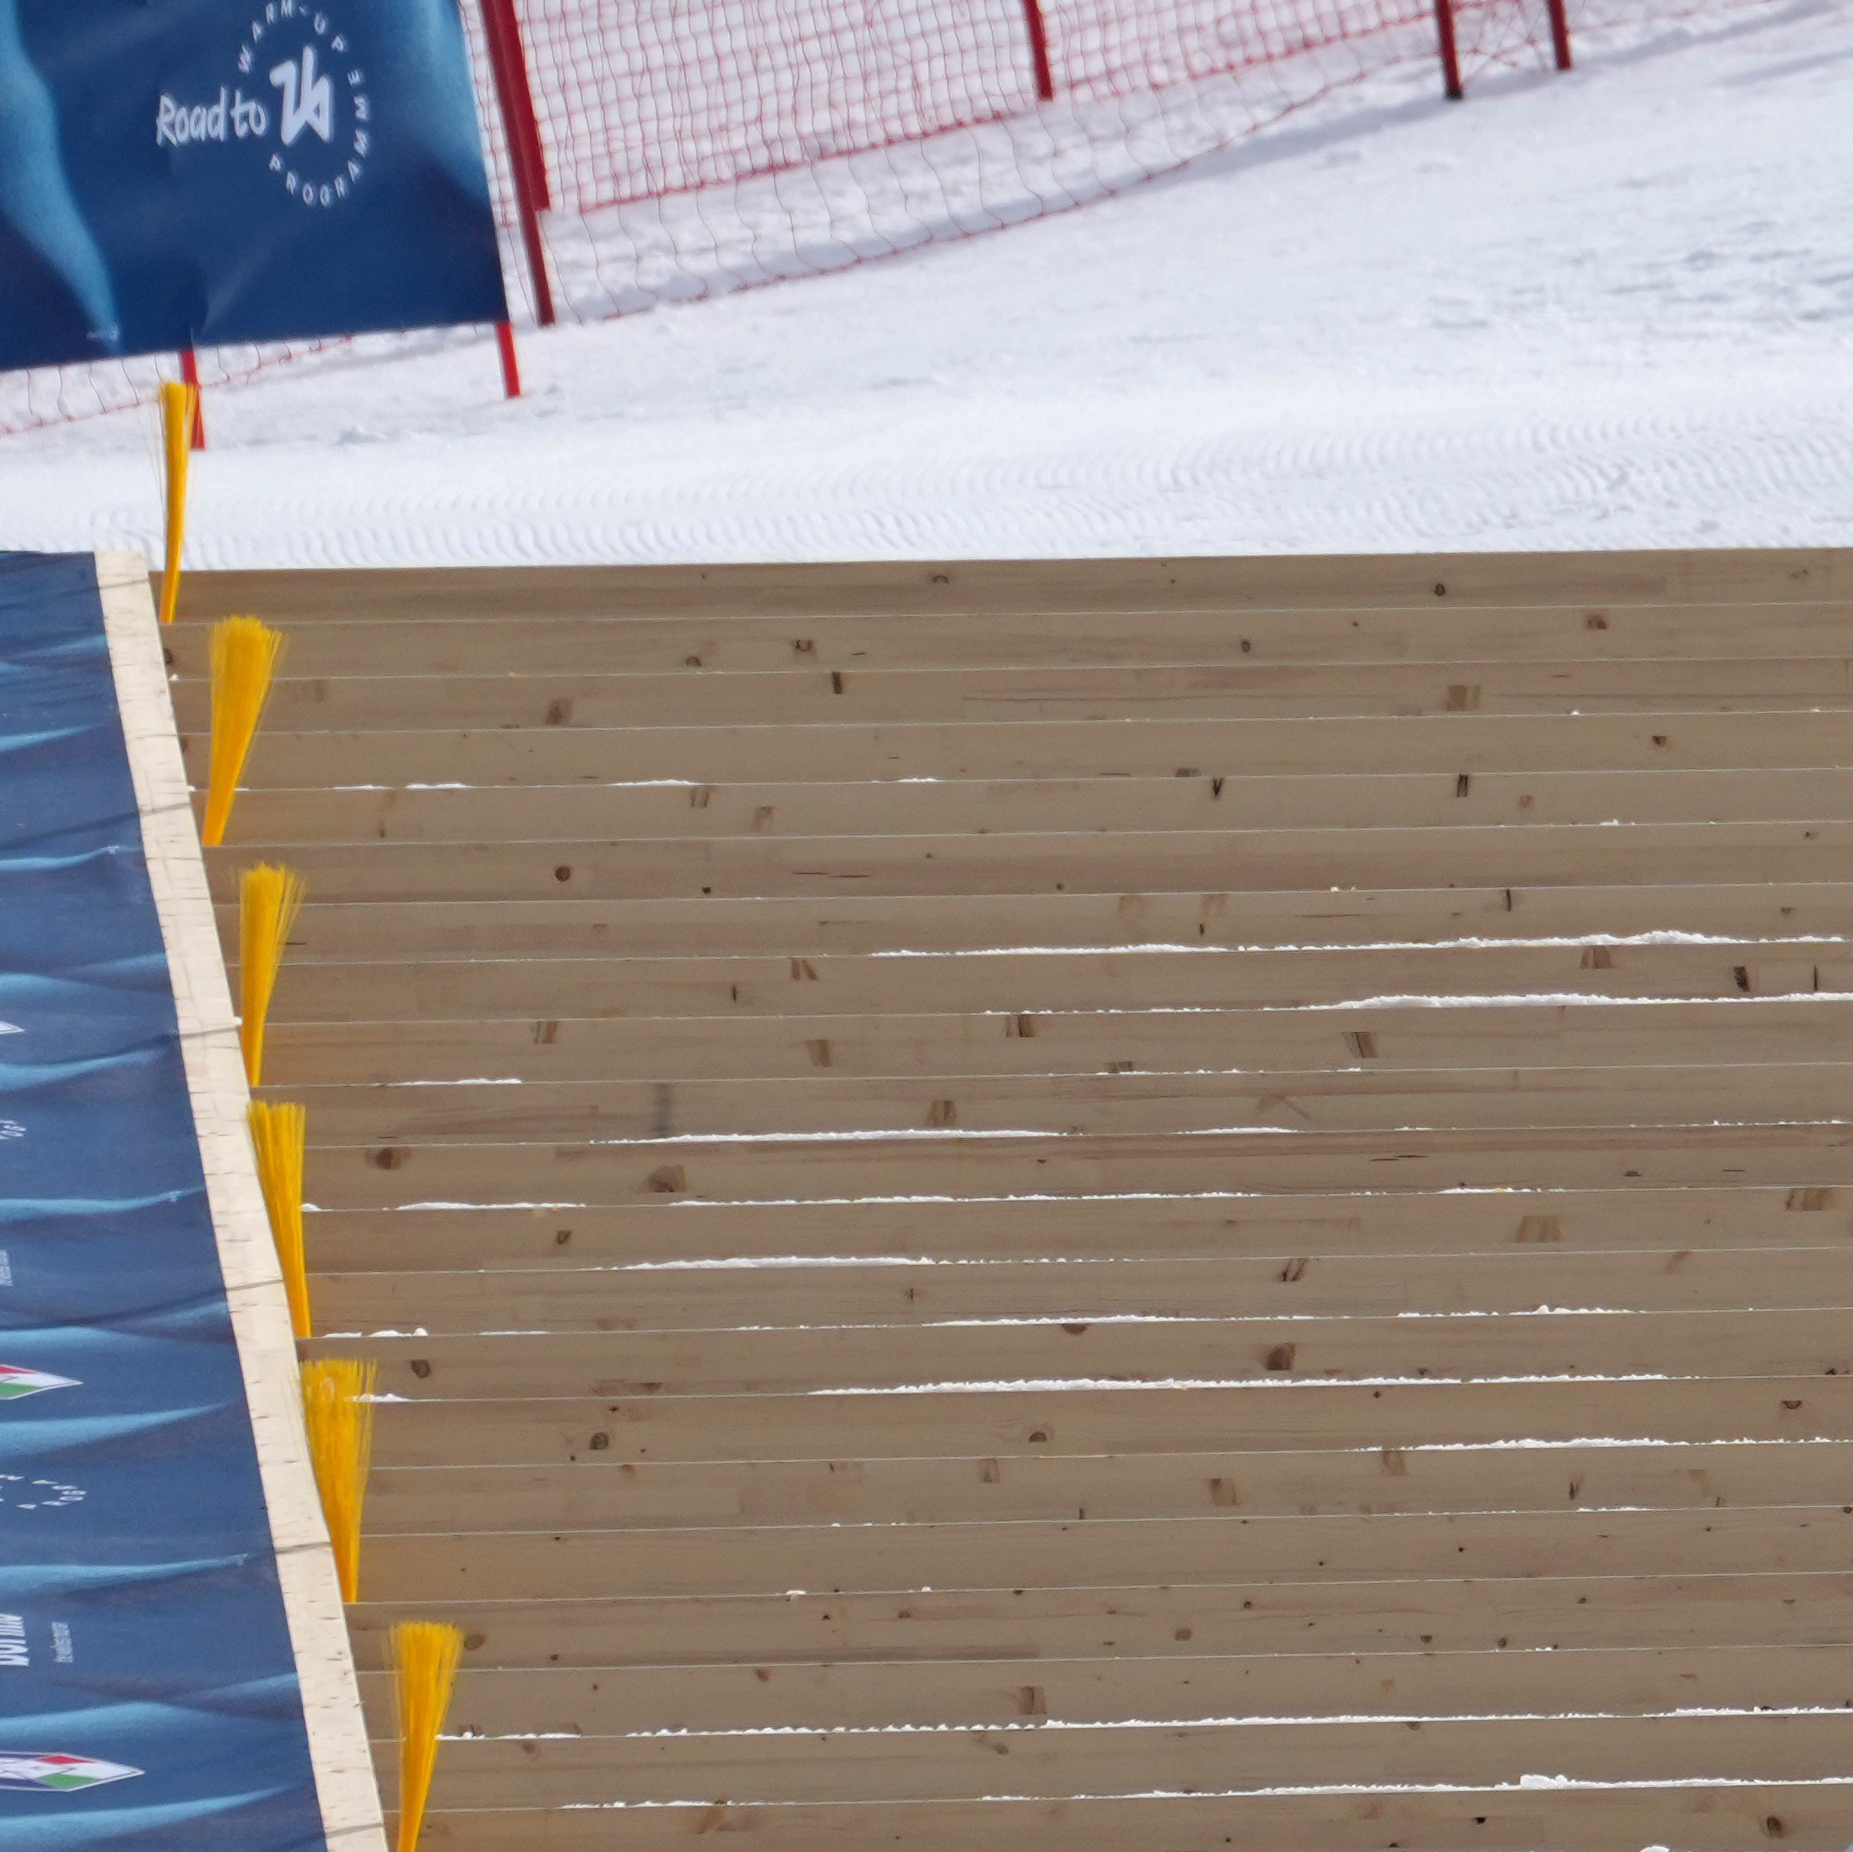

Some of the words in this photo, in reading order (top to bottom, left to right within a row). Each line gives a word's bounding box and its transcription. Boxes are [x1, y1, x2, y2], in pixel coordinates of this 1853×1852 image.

[156, 86, 226, 147] Road
[230, 89, 267, 138] to
[269, 69, 370, 207] PROGRAMME
